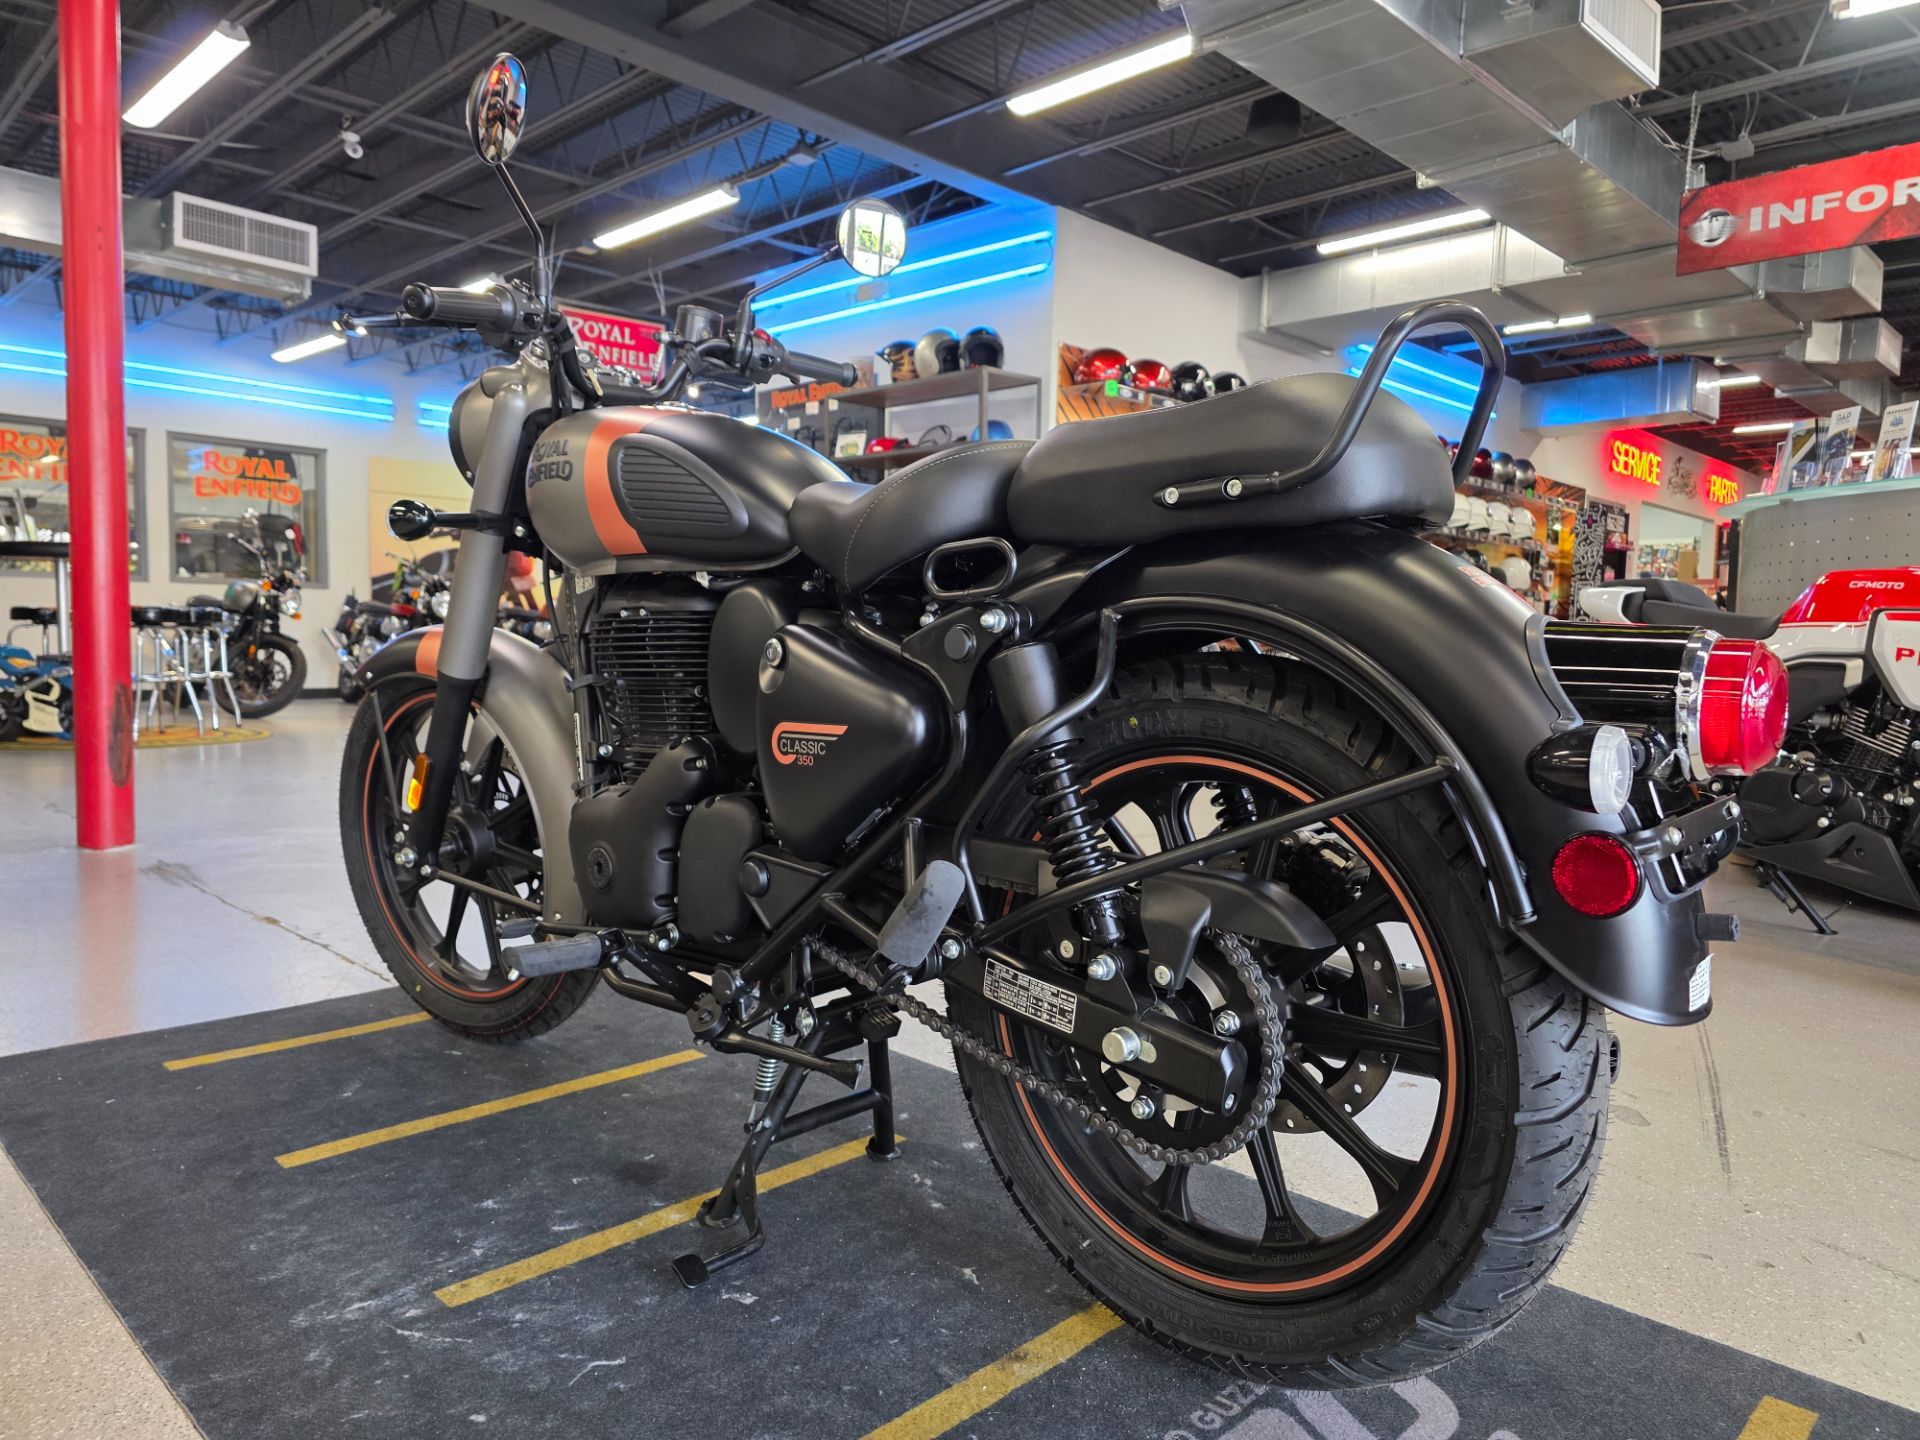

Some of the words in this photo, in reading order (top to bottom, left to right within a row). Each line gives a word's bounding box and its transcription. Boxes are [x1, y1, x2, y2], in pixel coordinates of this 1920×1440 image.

[567, 316, 636, 346] ROYAL
[0, 428, 68, 459] ROY
[203, 450, 291, 479] ROYAL
[1611, 440, 1662, 487] SERVICE
[193, 475, 302, 506] ENFIELD
[1708, 474, 1739, 506] PARTS
[1848, 580, 1906, 590] CFMOTO
[779, 738, 827, 756] CLASSIC
[796, 754, 815, 766] 350
